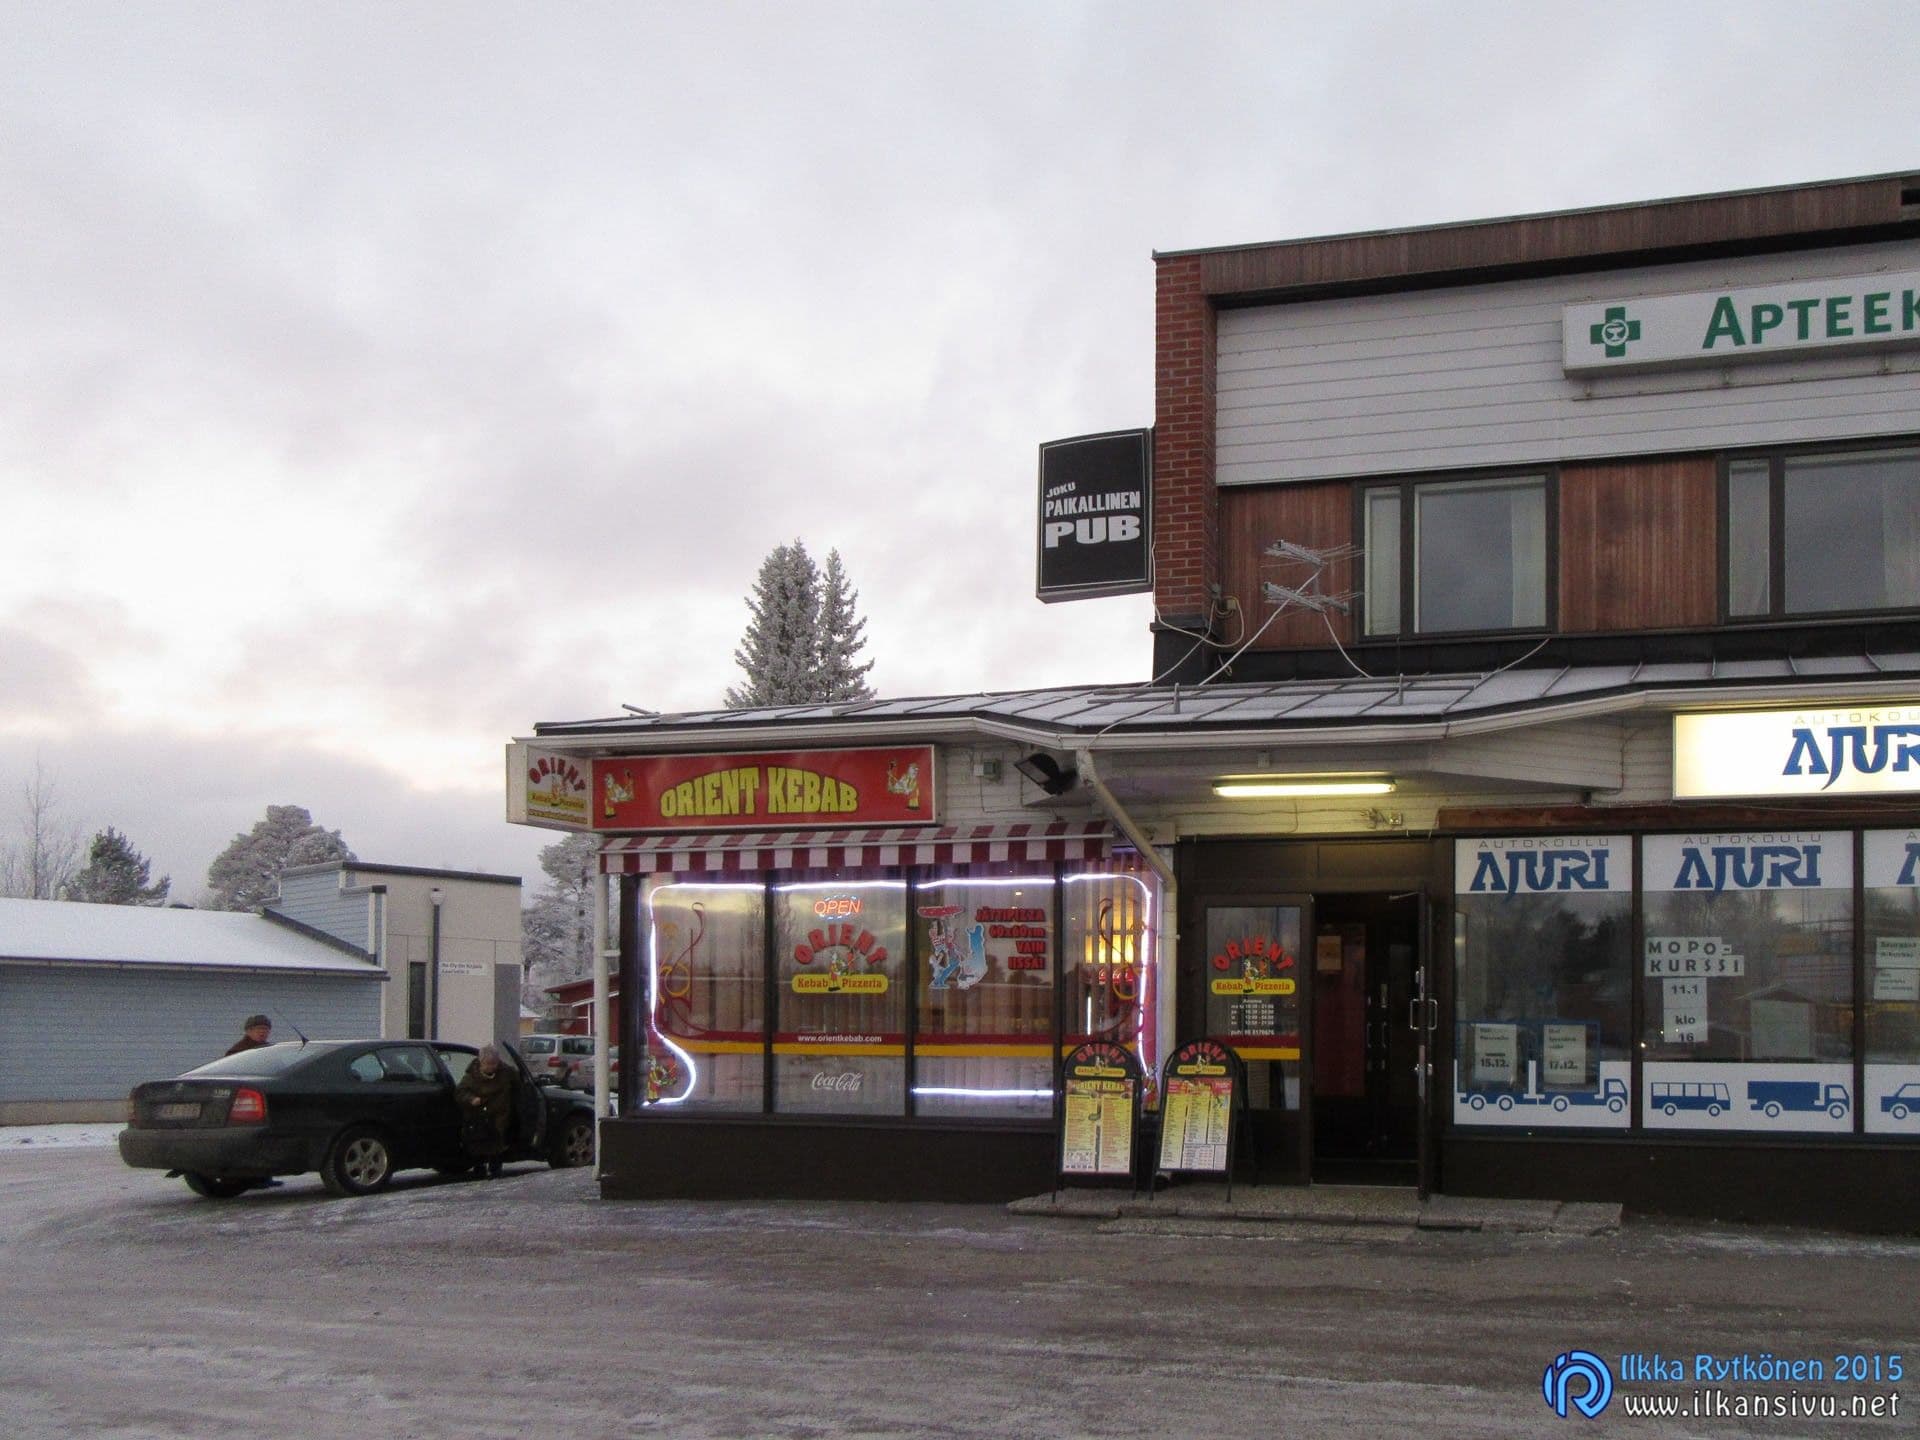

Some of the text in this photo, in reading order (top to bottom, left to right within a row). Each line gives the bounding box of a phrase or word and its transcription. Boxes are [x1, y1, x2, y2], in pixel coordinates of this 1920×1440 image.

[1046, 481, 1076, 498] JOKU
[1045, 491, 1141, 518] PAIKALLINEN
[1045, 515, 1141, 549] PUB
[660, 765, 858, 818] ORIENT KEBAB
[1479, 838, 1609, 849] AUTOKOULU
[1683, 833, 1822, 844] AUTOKOULU
[1469, 849, 1609, 899] AJURI
[1673, 845, 1822, 899] AJURI
[814, 899, 862, 915] OPEN
[794, 923, 888, 965] ORIENT
[1016, 940, 1046, 954] VAIN
[1649, 941, 1731, 955] MOPO-
[1212, 936, 1295, 972] ORIENT
[1650, 958, 1739, 972] KURSSI
[797, 978, 883, 988] Kebab Pizzeria
[1216, 982, 1290, 990] Kebab Pizzeria
[1675, 1015, 1696, 1025] klo
[798, 1034, 882, 1043] www.orientkebab.com
[1679, 1032, 1695, 1042] 16
